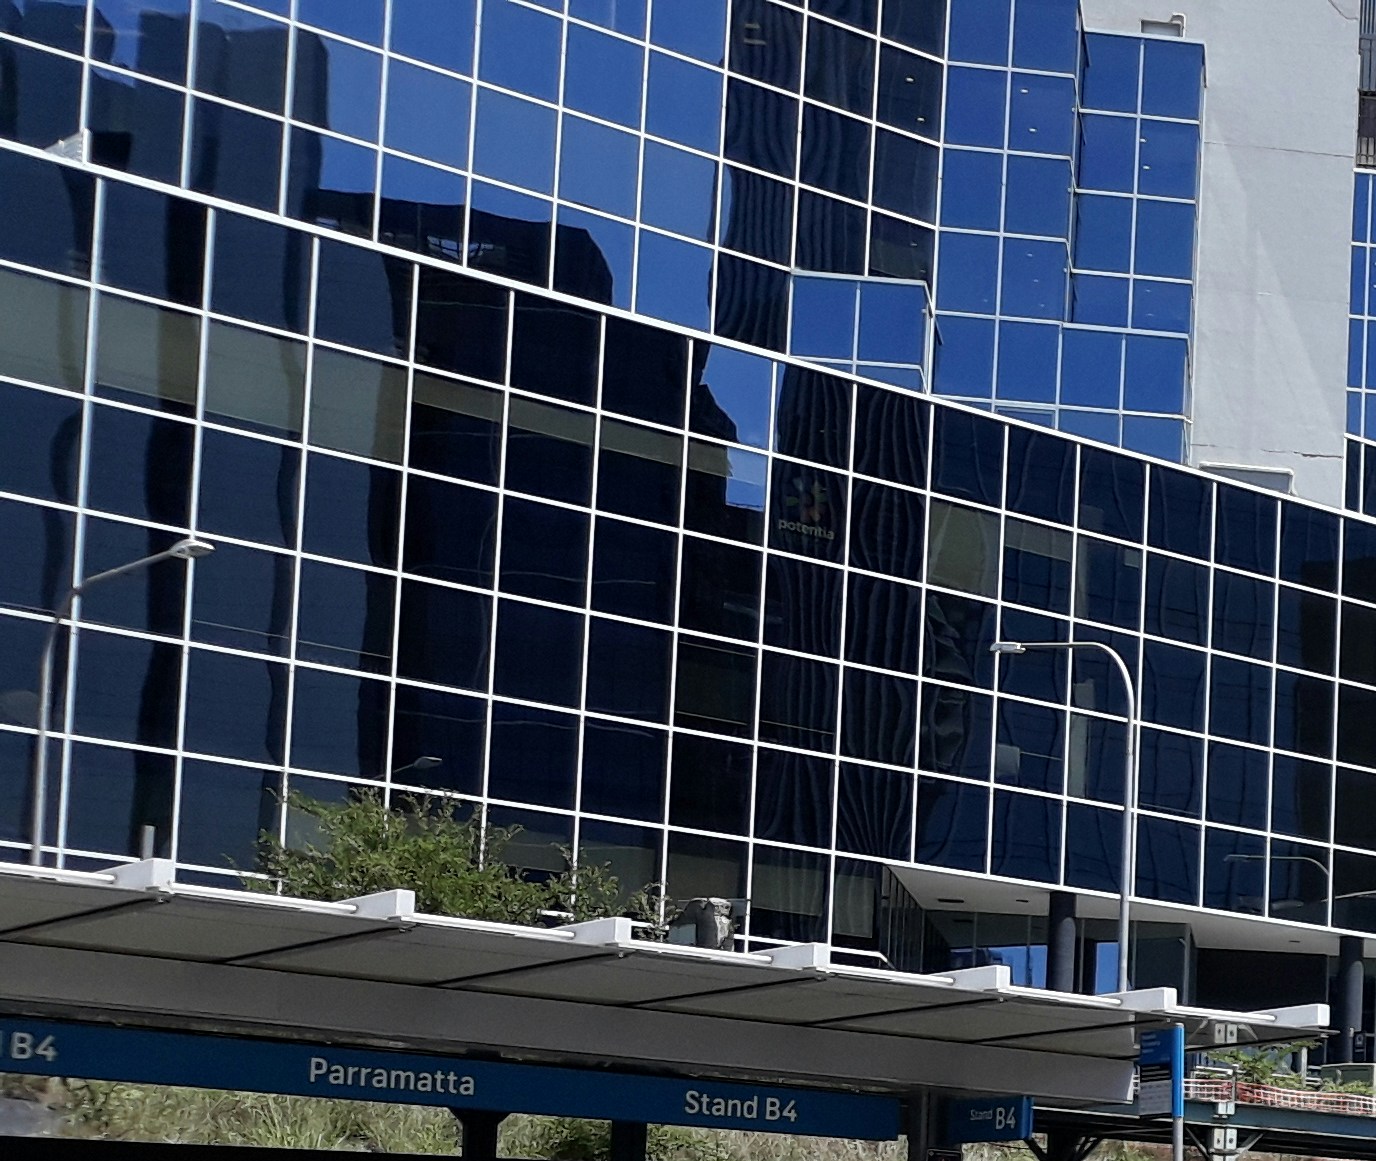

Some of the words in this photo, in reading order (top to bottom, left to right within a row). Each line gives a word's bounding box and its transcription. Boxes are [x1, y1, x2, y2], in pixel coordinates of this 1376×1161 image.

[778, 519, 834, 540] potentia
[10, 1031, 58, 1062] B4
[309, 1057, 475, 1096] Parramatta
[684, 1090, 758, 1119] Stand
[765, 1097, 798, 1122] B4
[970, 1108, 993, 1120] Stand
[995, 1106, 1016, 1130] B4
